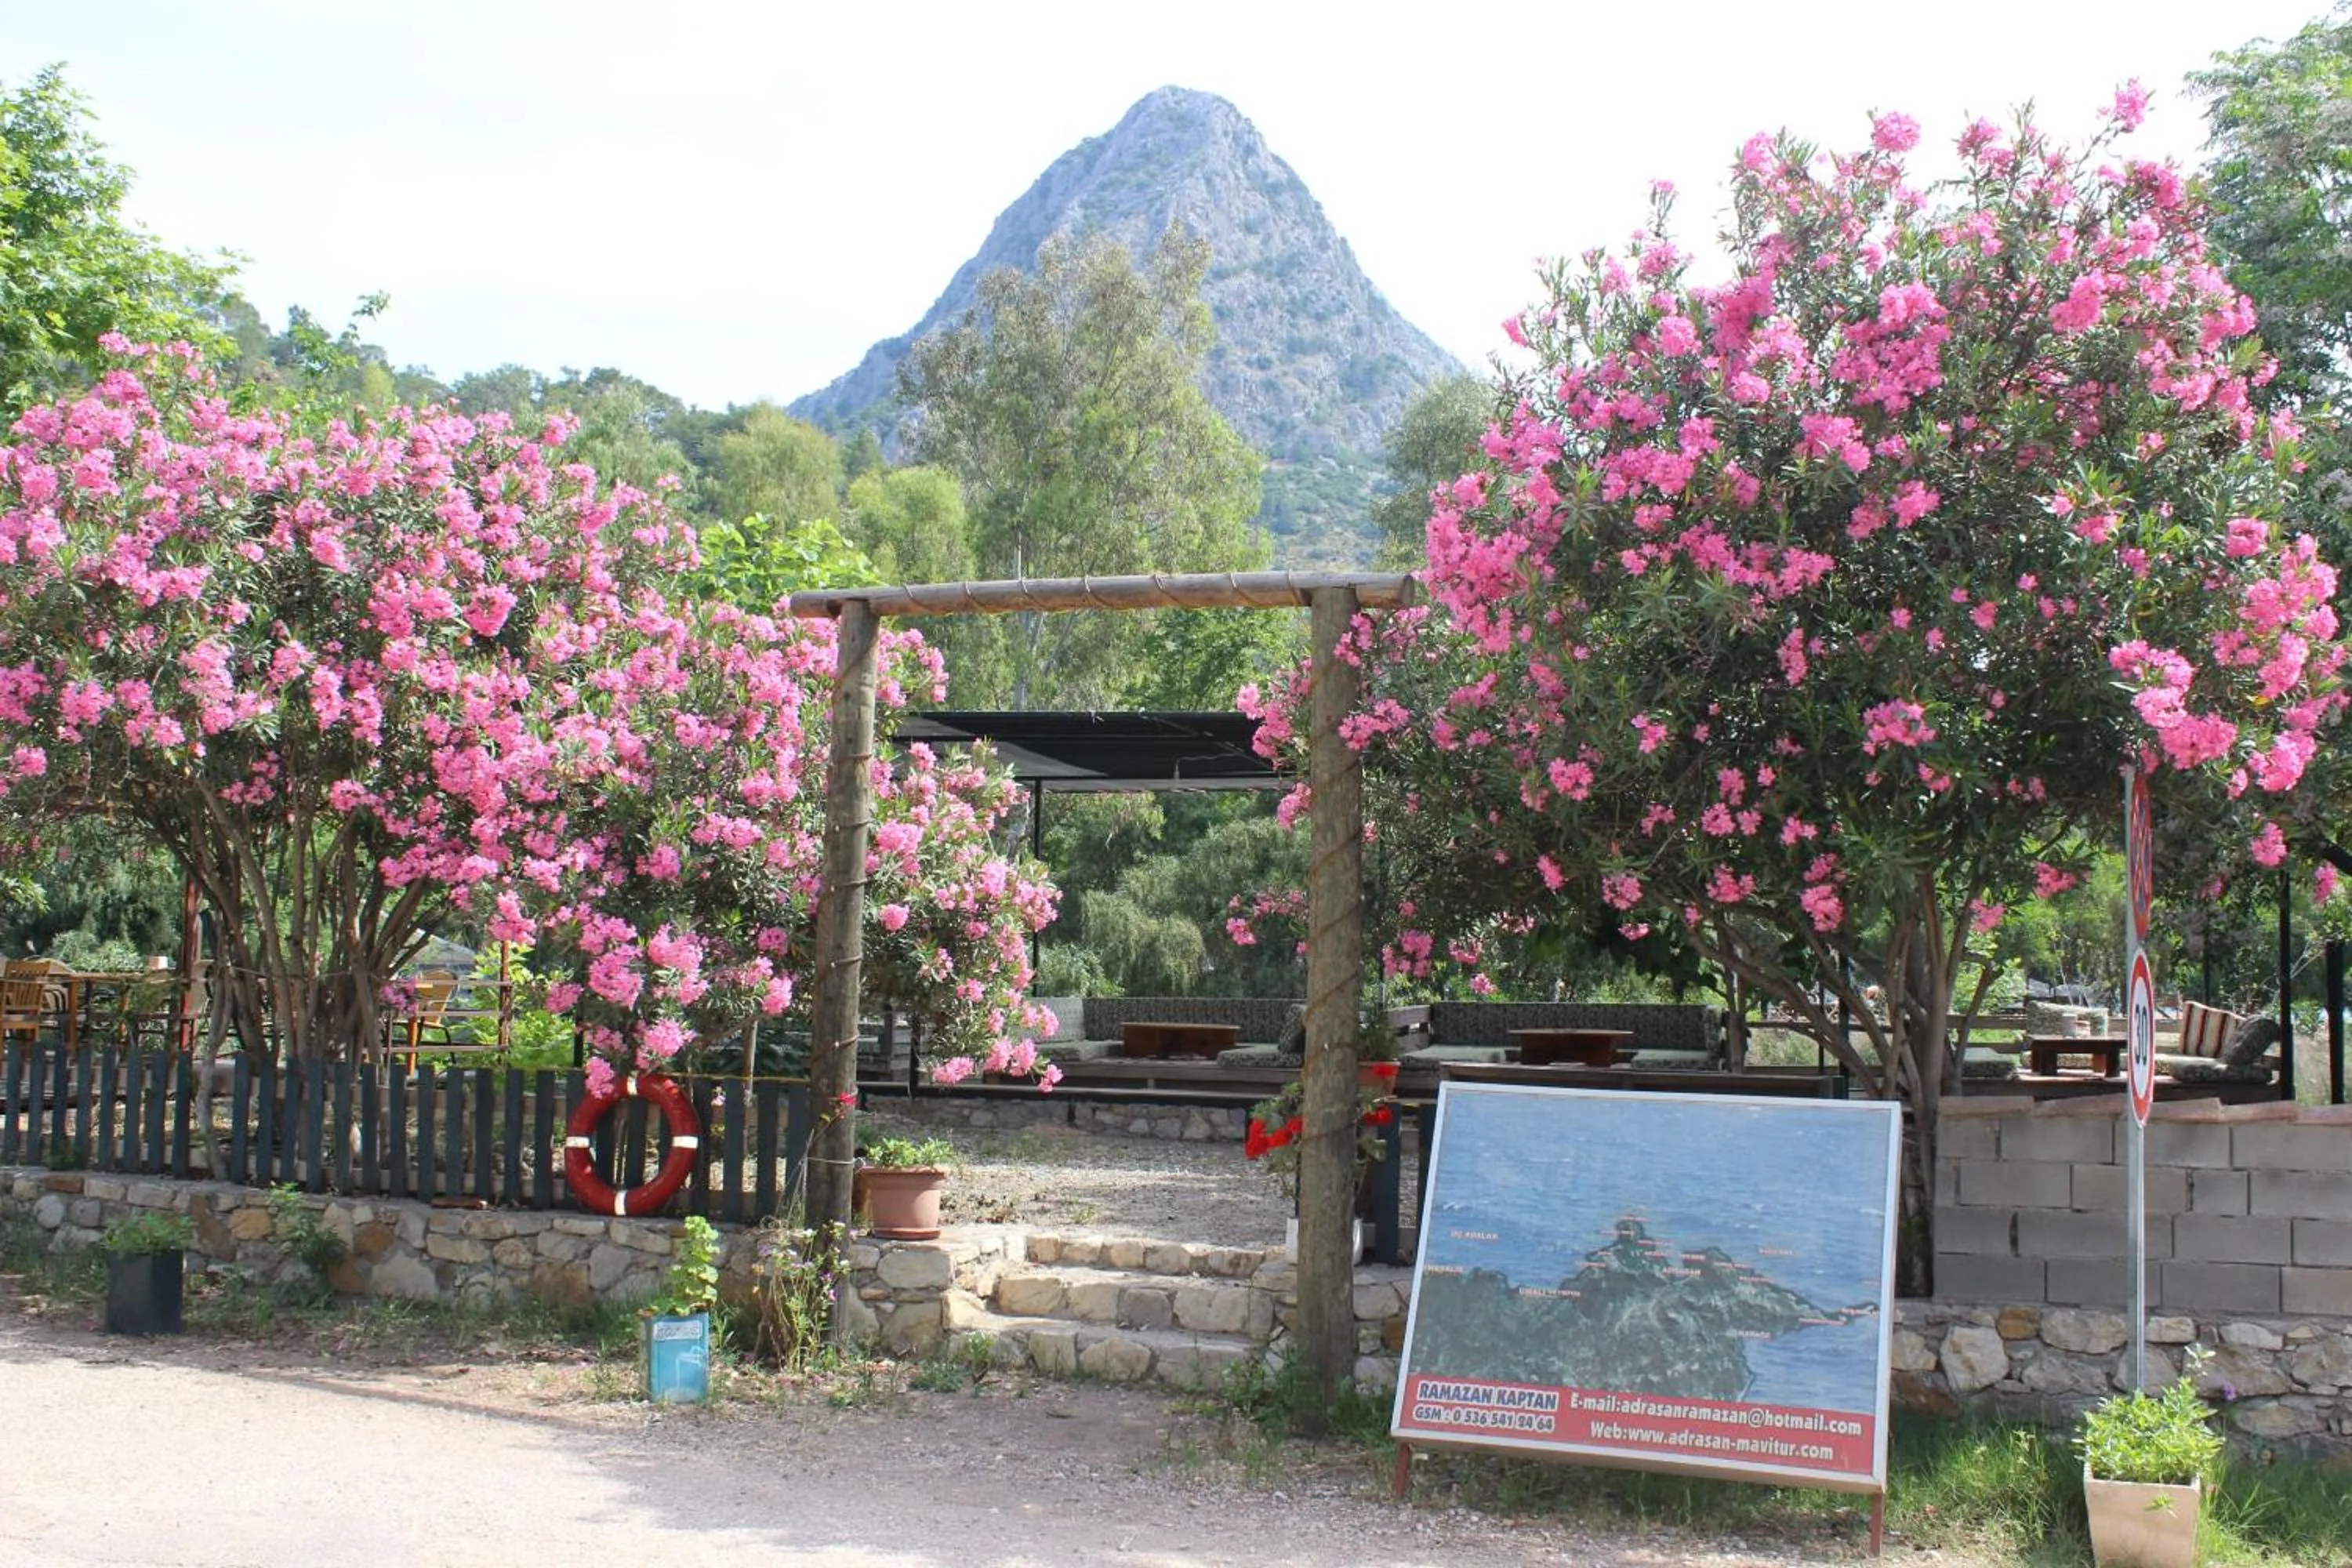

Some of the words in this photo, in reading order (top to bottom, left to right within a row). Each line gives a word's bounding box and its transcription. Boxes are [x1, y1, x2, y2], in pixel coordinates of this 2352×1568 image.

[2134, 1004, 2148, 1065] 30
[1418, 1382, 1494, 1404] RAMAZAN
[1495, 1388, 1557, 1410] KAPTAN
[1414, 1405, 1442, 1421] GSM
[1453, 1408, 1461, 1422] 0
[1464, 1410, 1487, 1425] 536
[1490, 1412, 1514, 1427] 541
[1536, 1416, 1554, 1432] 64
